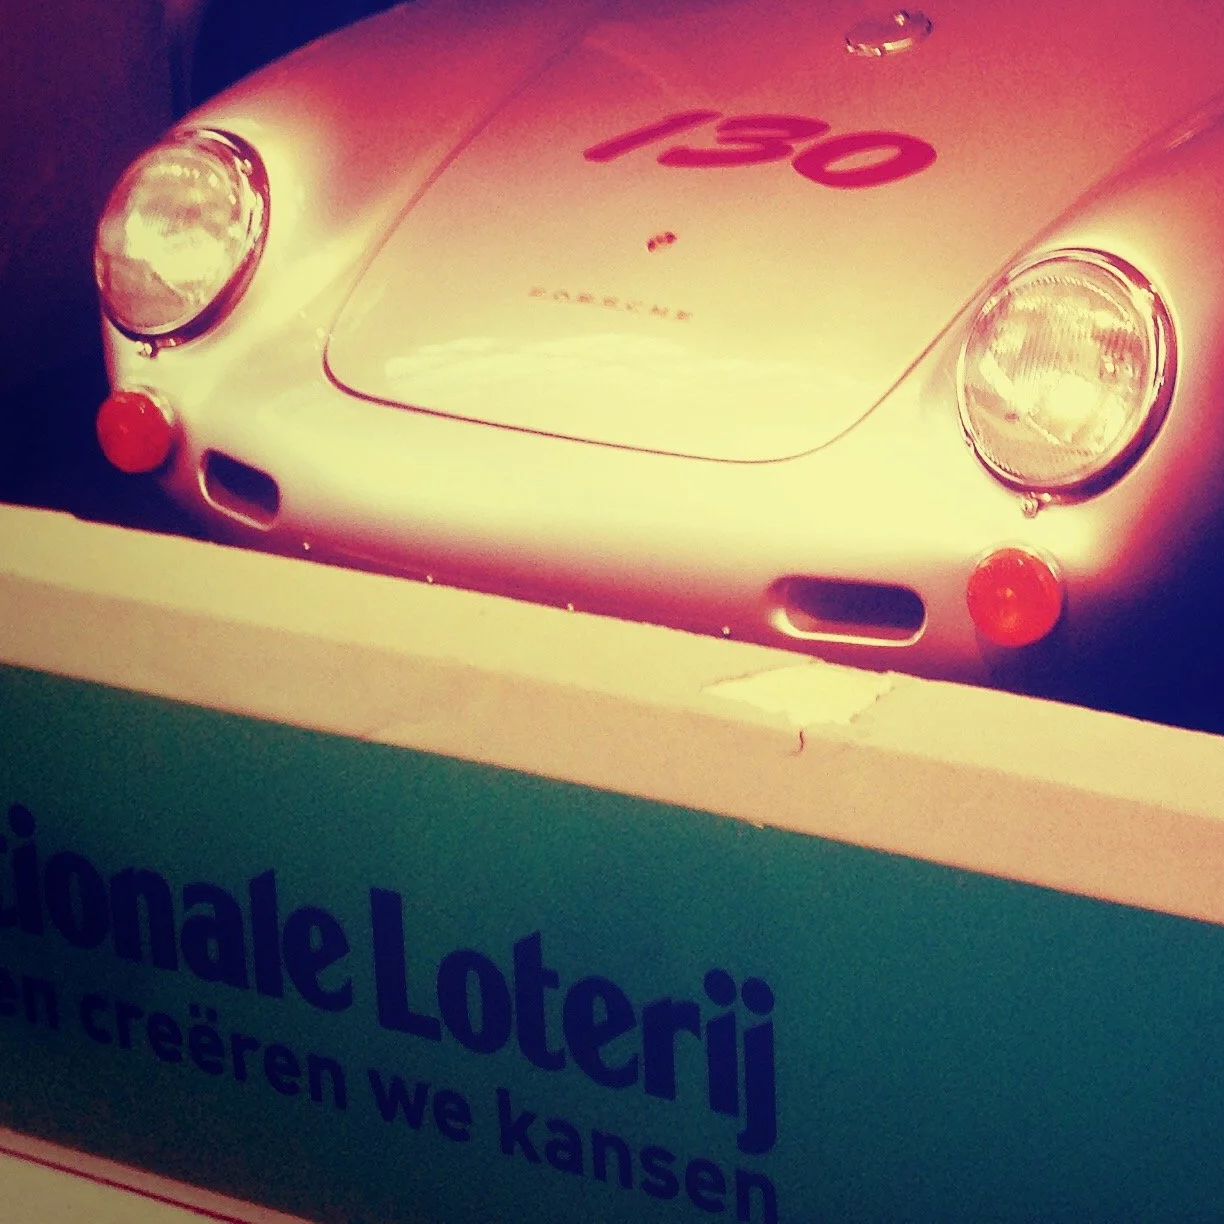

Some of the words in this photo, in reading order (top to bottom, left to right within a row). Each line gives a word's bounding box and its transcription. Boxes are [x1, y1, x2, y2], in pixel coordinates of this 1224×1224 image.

[583, 109, 938, 190] 130
[0, 804, 352, 1013] ionale
[369, 887, 777, 1156] Loterij
[80, 992, 347, 1110] creëren
[367, 1067, 473, 1143] we
[496, 1086, 779, 1224] kansen
